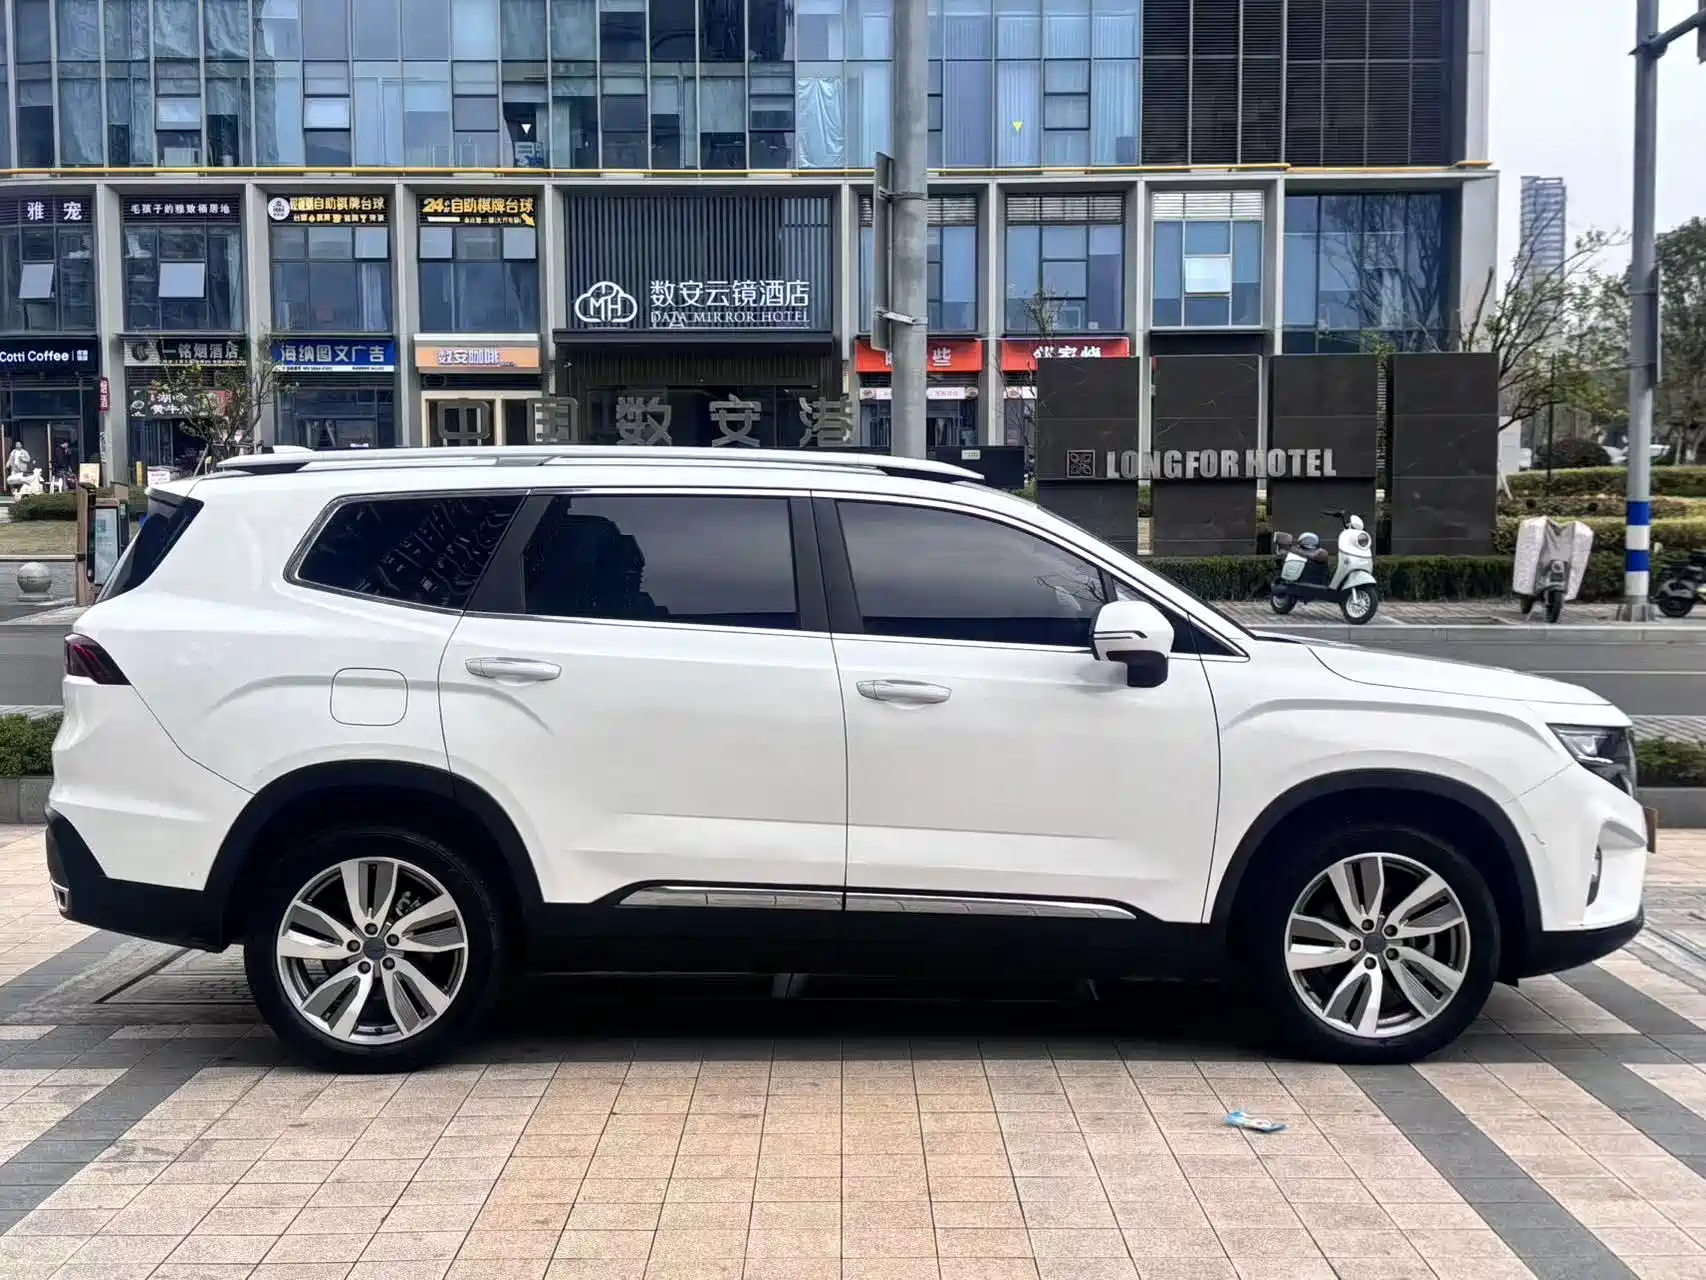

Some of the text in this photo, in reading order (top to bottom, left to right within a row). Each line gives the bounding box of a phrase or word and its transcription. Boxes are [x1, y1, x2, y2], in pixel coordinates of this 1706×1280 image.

[650, 280, 810, 307] 数安云镜酒店
[650, 311, 810, 323] DATA MIRROR HOTEL
[0, 351, 25, 363] Cotti
[27, 350, 69, 362] Coffee
[1106, 448, 1337, 479] LONGFOR HOTEL
